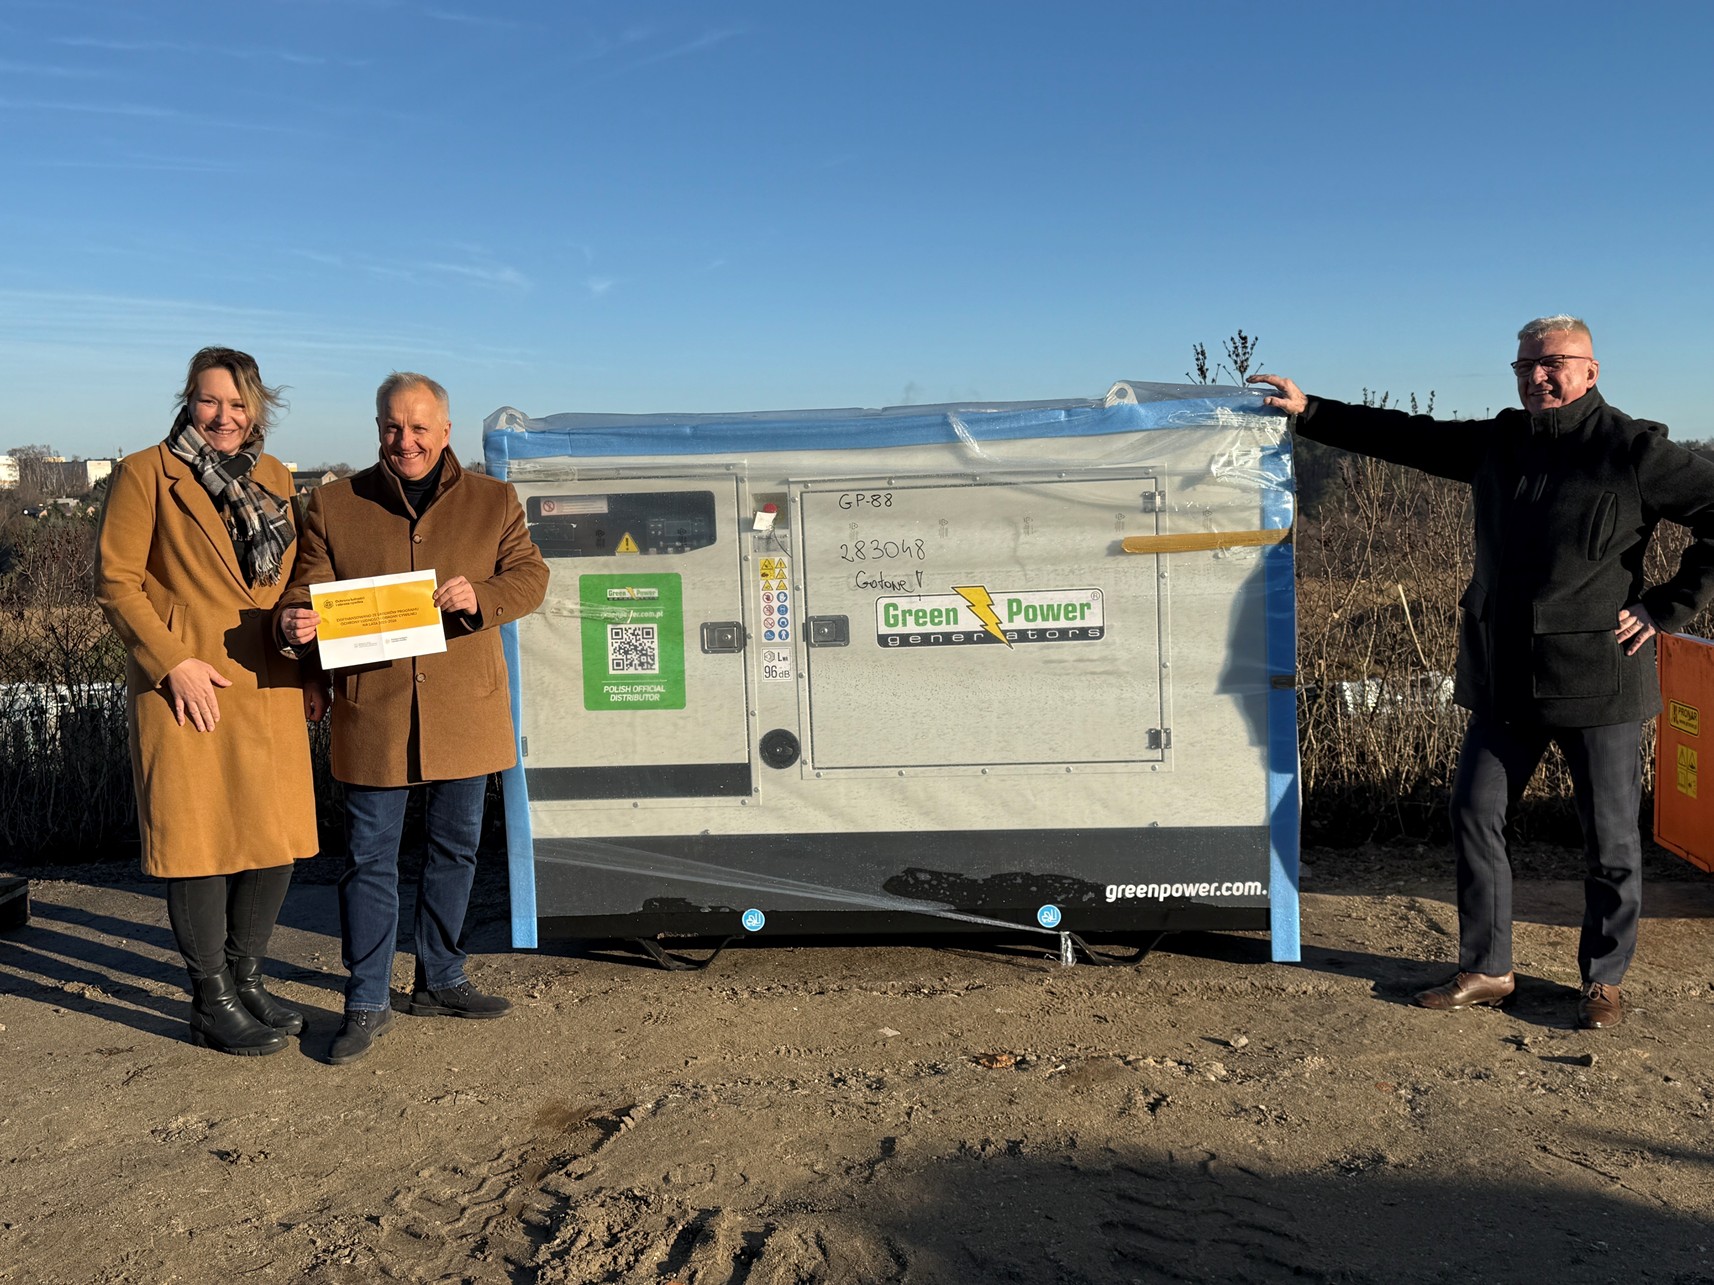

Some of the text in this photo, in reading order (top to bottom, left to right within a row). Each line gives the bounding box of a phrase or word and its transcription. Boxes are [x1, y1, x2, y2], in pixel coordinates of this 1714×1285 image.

[840, 539, 926, 562] 283048
[608, 589, 627, 597] Green
[883, 602, 959, 628] Green
[1007, 597, 1093, 624] Power
[888, 627, 1100, 646] generators
[764, 665, 791, 679] 96 dB
[603, 684, 666, 693] POLISH OFFICIAL
[610, 693, 661, 702] DISTRIBUTOR
[1105, 880, 1269, 902] greenpower.com.
